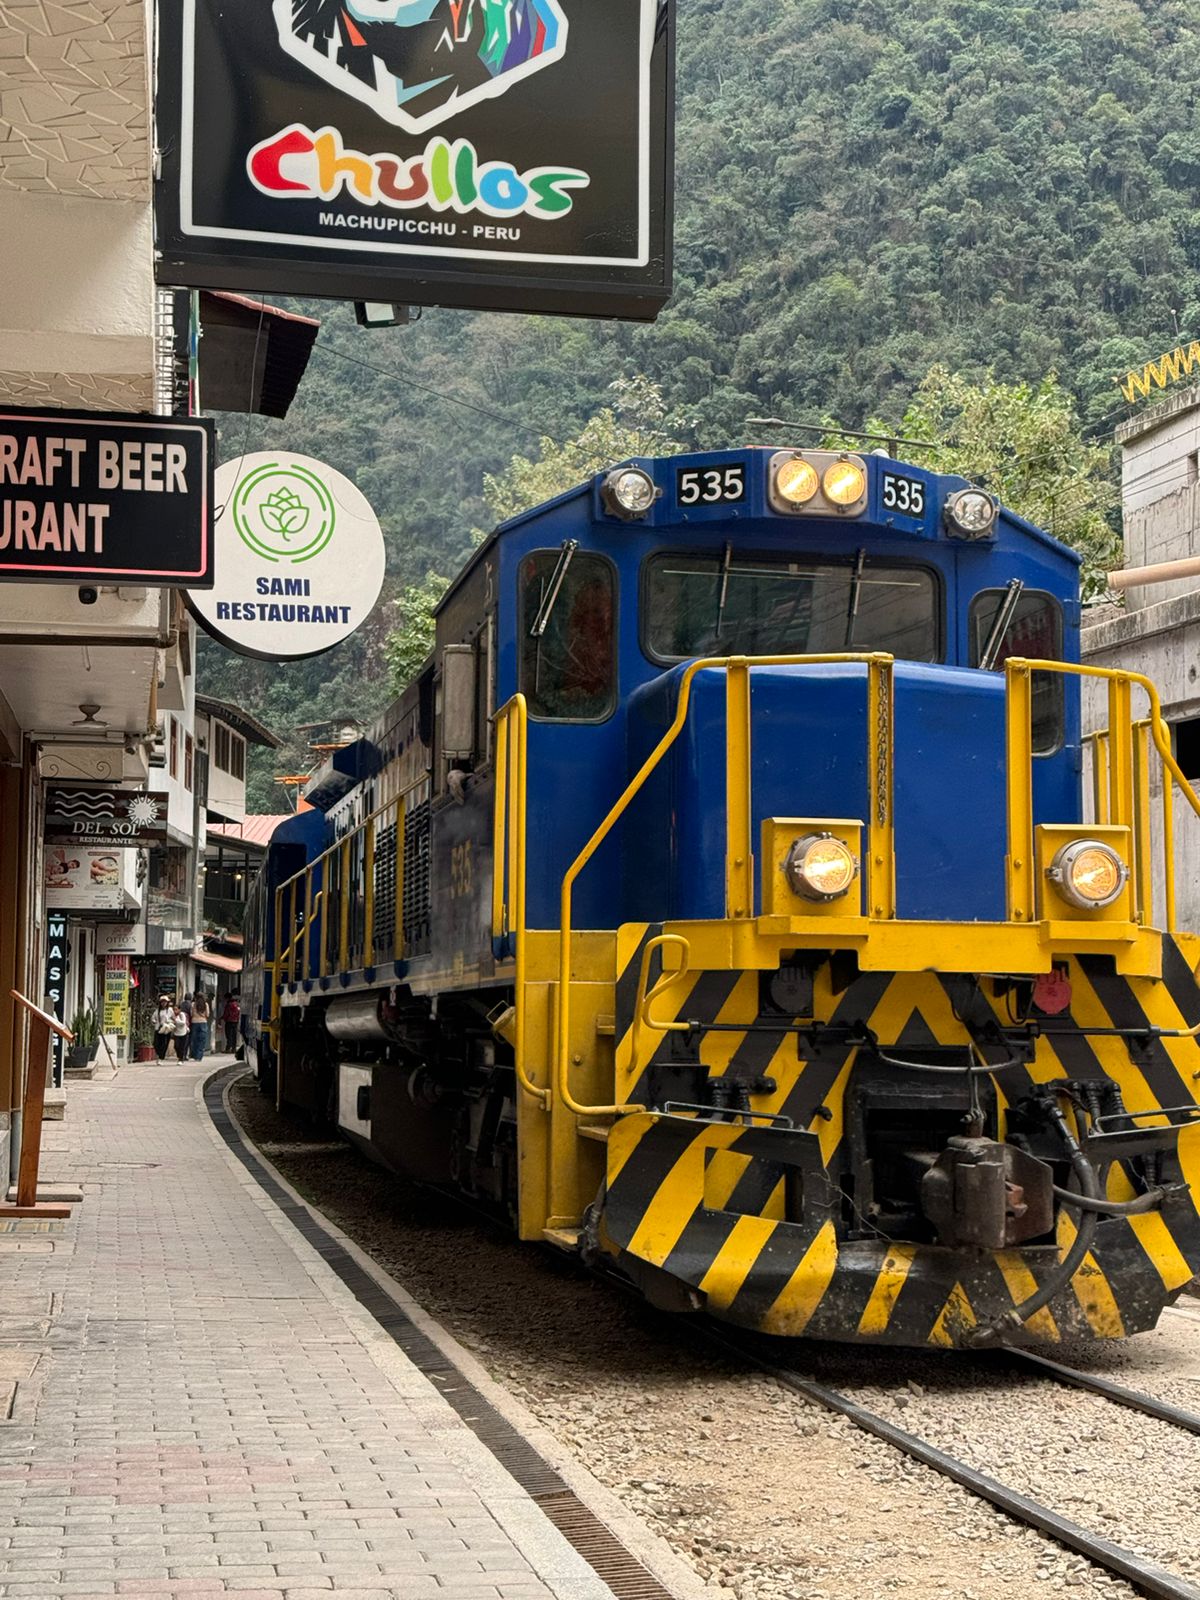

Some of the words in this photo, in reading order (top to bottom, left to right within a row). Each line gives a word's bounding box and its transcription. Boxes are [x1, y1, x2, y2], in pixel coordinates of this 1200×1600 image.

[247, 124, 590, 219] Chullos
[319, 212, 456, 236] MACHUPICCHU
[473, 225, 520, 241] PERU
[99, 439, 188, 494] BEER
[681, 468, 744, 504] 535
[883, 476, 923, 514] 535
[256, 576, 310, 597] SAMI
[216, 601, 351, 624] RESTAURANT
[72, 821, 104, 834] DEL
[110, 822, 140, 836] SOL
[79, 836, 132, 845] RESTAURANTE
[105, 1026, 124, 1035] PESOS
